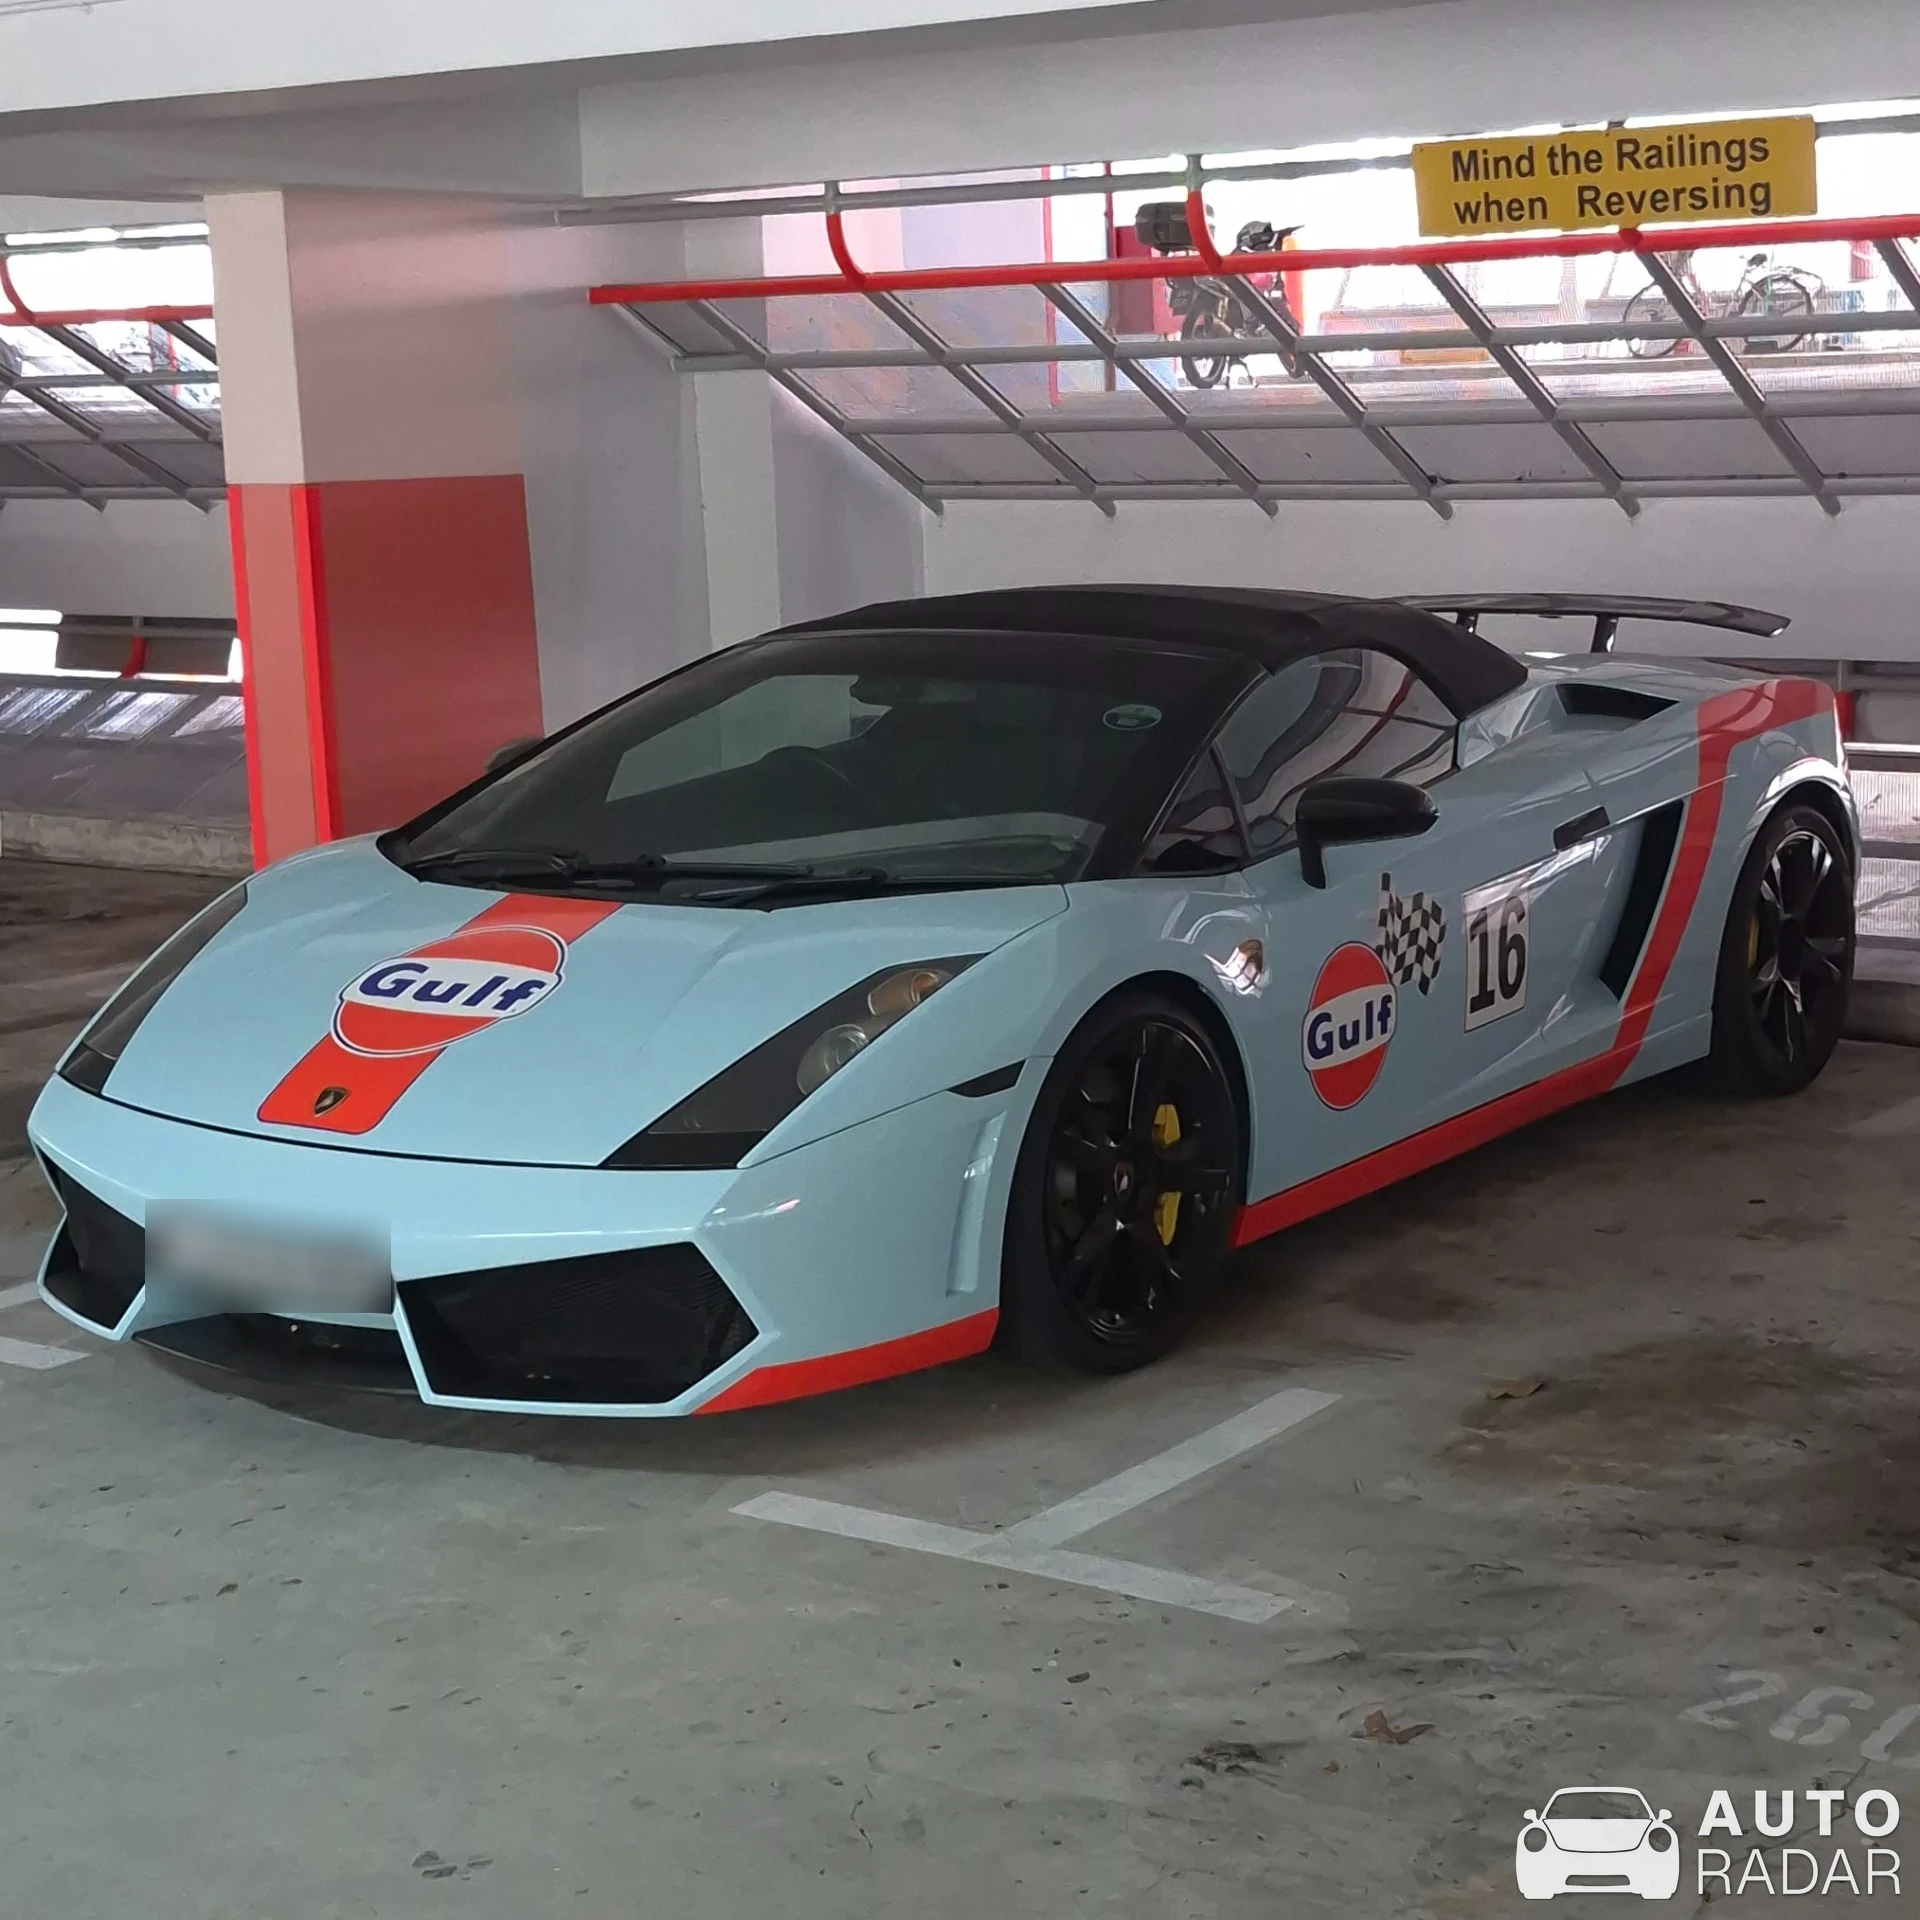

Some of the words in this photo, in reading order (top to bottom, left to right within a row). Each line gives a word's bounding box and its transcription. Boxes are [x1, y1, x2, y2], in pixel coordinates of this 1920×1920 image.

[1452, 144, 1535, 183] Mind
[1547, 141, 1603, 177] the
[1616, 135, 1770, 172] Railings
[1453, 192, 1548, 225] when
[1577, 177, 1772, 216] Reversing
[1469, 895, 1526, 1014] 16
[358, 962, 548, 1012] Gulf
[1306, 994, 1393, 1060] Gulf
